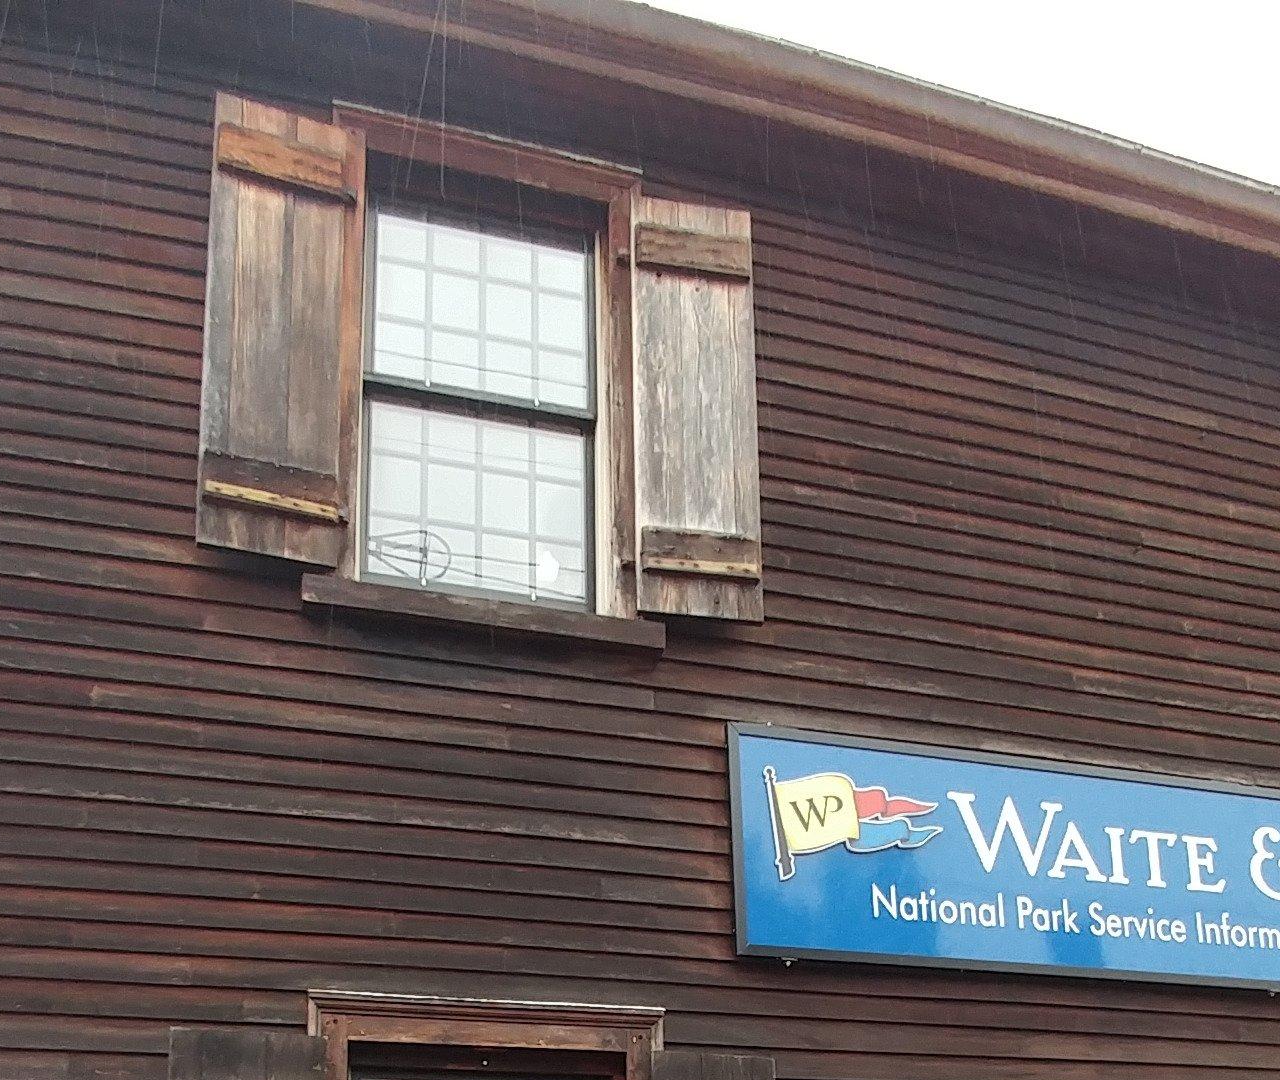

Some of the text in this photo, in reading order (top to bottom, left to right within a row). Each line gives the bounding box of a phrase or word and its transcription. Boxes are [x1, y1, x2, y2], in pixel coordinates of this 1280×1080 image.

[789, 795, 843, 832] WP
[946, 790, 1226, 894] WAITE
[871, 882, 1005, 928] National
[1017, 896, 1080, 934] Park
[1088, 901, 1187, 943] Service
